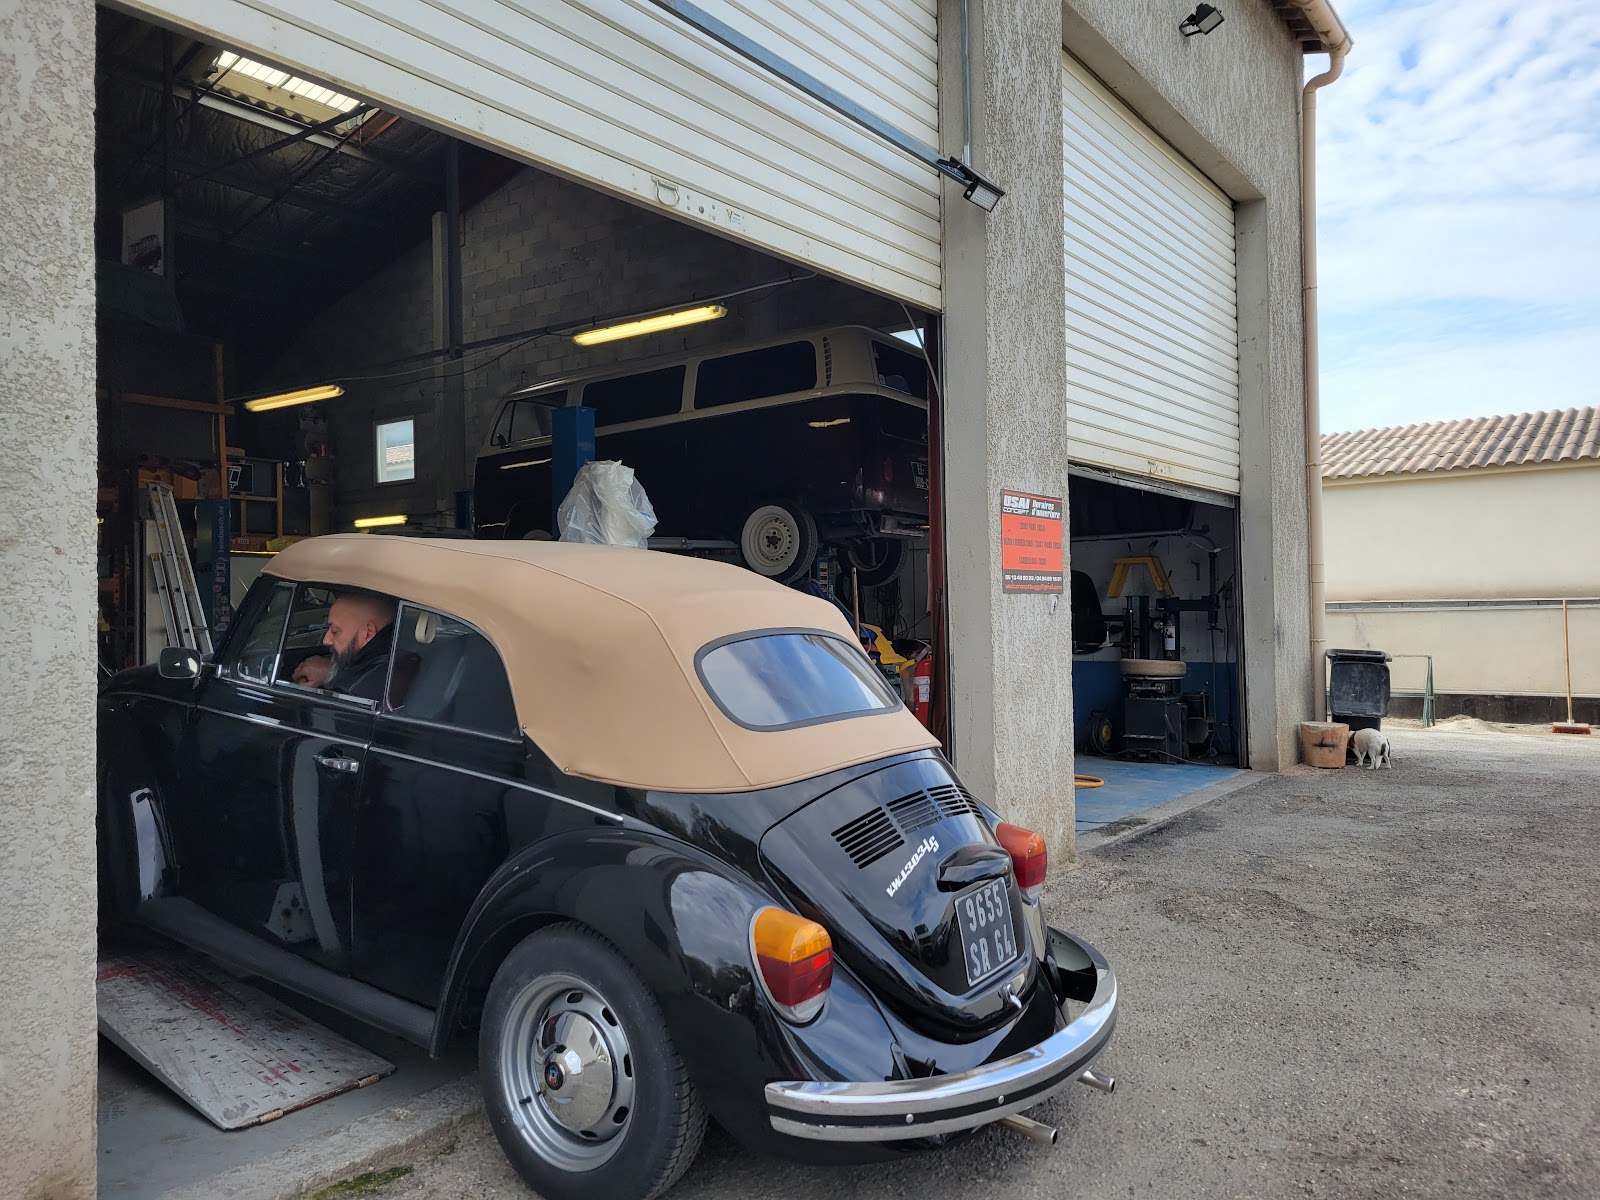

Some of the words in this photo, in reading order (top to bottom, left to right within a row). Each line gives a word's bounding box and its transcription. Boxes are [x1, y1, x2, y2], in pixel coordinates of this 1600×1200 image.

[965, 884, 1003, 932] 9655
[970, 937, 991, 977] SR
[994, 924, 1012, 962] 64
